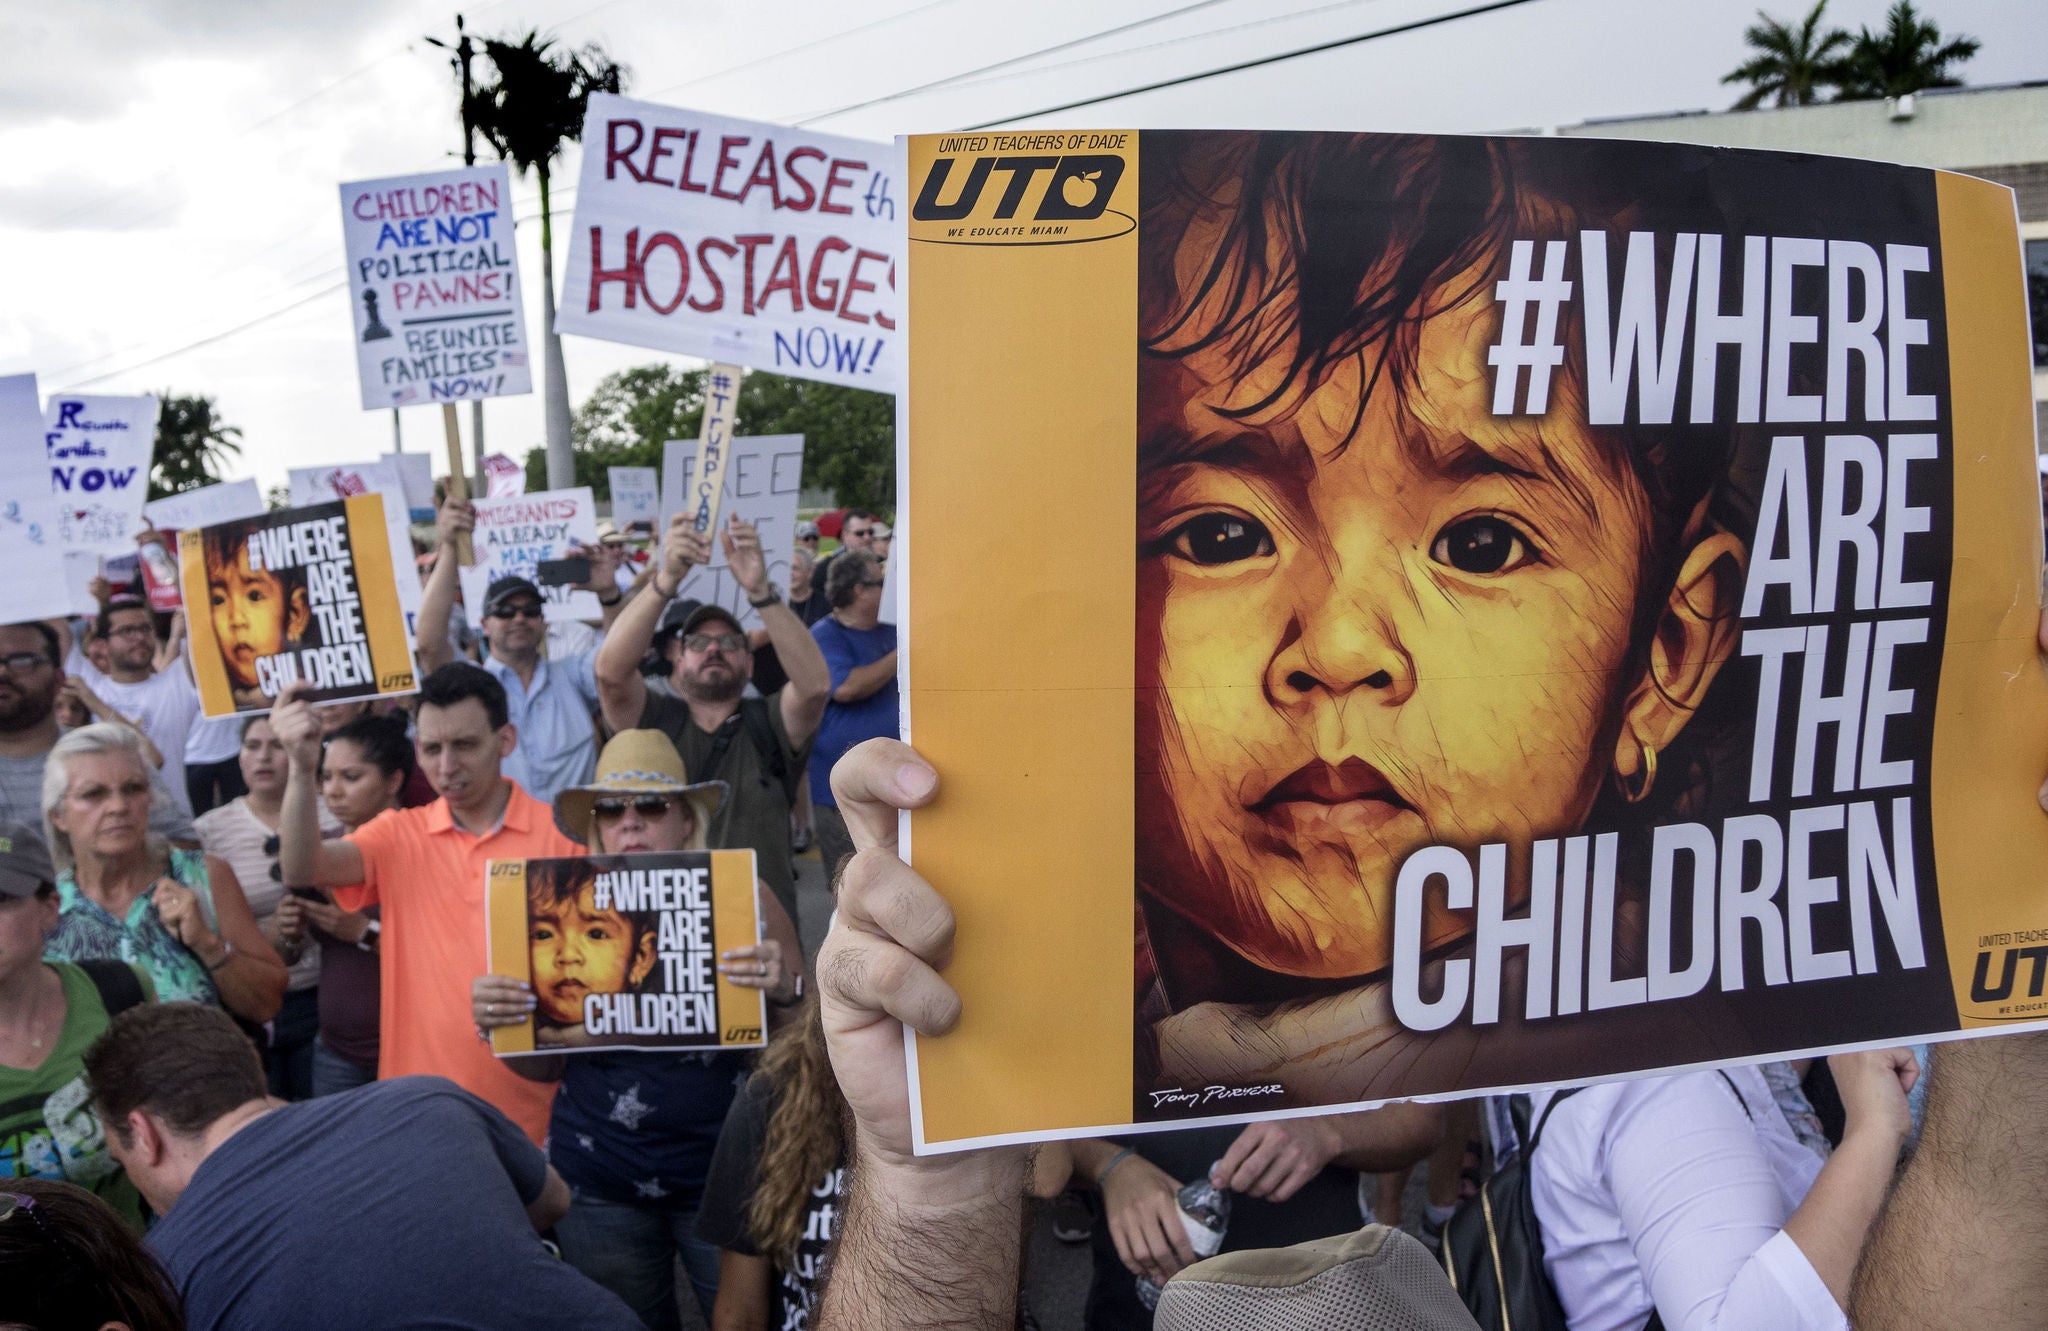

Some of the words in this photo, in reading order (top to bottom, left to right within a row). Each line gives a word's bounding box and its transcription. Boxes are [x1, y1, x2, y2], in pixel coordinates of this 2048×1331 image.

[939, 137, 988, 153] UNITED
[993, 135, 1064, 151] TEACHERS
[1067, 135, 1087, 149] OF
[1088, 134, 1128, 149] DADE
[606, 119, 868, 215] RELEASE
[862, 171, 896, 221] th
[912, 155, 1126, 221] UTD
[352, 179, 499, 222] CHILDREN
[376, 218, 431, 250] ARE
[435, 211, 497, 245] NOT
[948, 228, 965, 237] WE
[970, 227, 1025, 236] EDUCATE
[1030, 226, 1069, 235] MIAMI
[359, 242, 511, 283] POLITICAL
[393, 273, 512, 311] PAWNS!
[404, 322, 517, 353] REUNITE
[1488, 230, 1938, 426] #WHERE
[381, 350, 498, 385] FAMILIES
[774, 327, 885, 375] NOW!
[430, 374, 505, 400] NOW!
[51, 466, 137, 493] NOW
[682, 451, 804, 500] FEE
[475, 499, 578, 527] MMIGRANTS
[1740, 433, 1938, 619] ARE
[247, 515, 349, 572] #WHERE
[488, 522, 569, 546] ALREADY
[306, 558, 358, 605] ARE
[311, 601, 366, 646] THE
[254, 642, 373, 698] CHILDREN
[382, 673, 415, 689] UTD
[1741, 617, 1930, 803] THE
[490, 862, 522, 876] UTD
[593, 867, 710, 912] #WHERE
[657, 910, 713, 951] ARE
[1392, 797, 1927, 1032] CHILDREN
[1979, 933, 2011, 947] UNITED
[2014, 929, 2048, 943] TEACHE
[658, 951, 715, 993] THE
[1970, 945, 2048, 1003] UT
[584, 993, 717, 1036] CHILDREN
[1999, 1006, 2011, 1014] WE
[2015, 1002, 2048, 1013] EDUCAT
[725, 1029, 762, 1042] UTD
